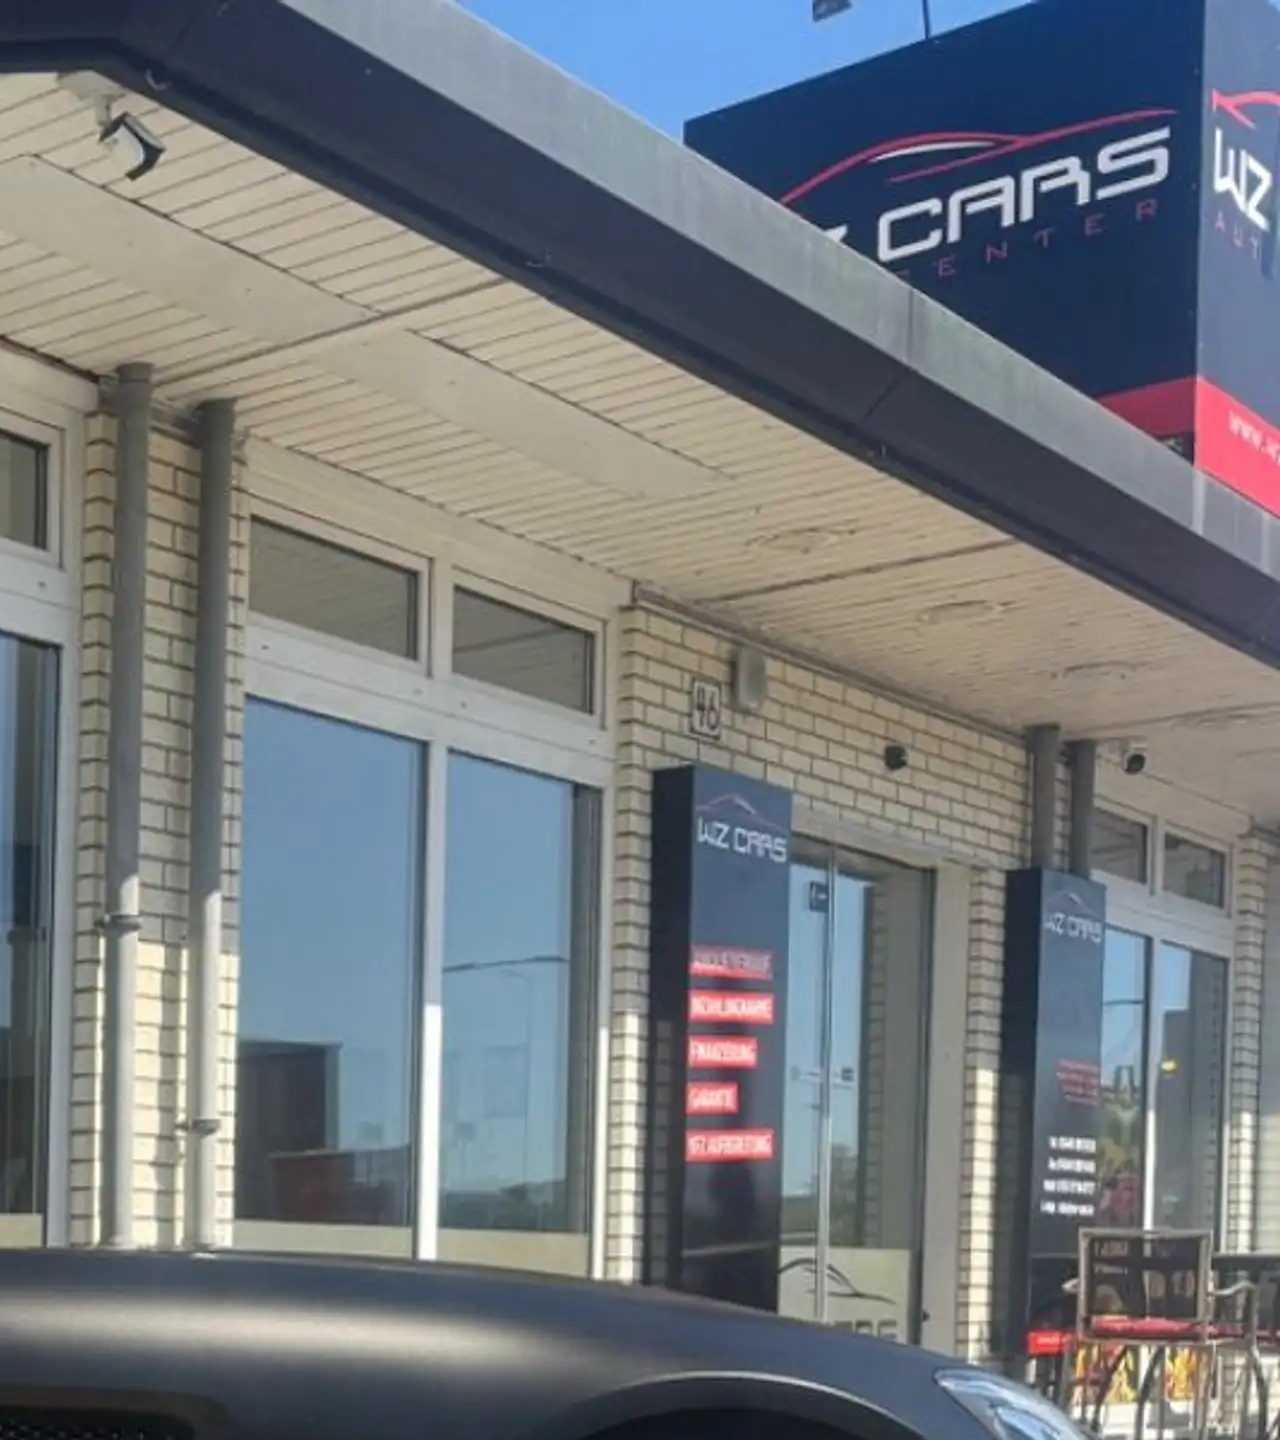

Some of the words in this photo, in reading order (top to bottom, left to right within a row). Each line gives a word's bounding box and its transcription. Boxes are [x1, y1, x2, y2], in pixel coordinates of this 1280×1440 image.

[877, 126, 1171, 263] CARS
[1213, 126, 1273, 232] WZ
[697, 816, 730, 849] WZ
[733, 826, 787, 863] CARS
